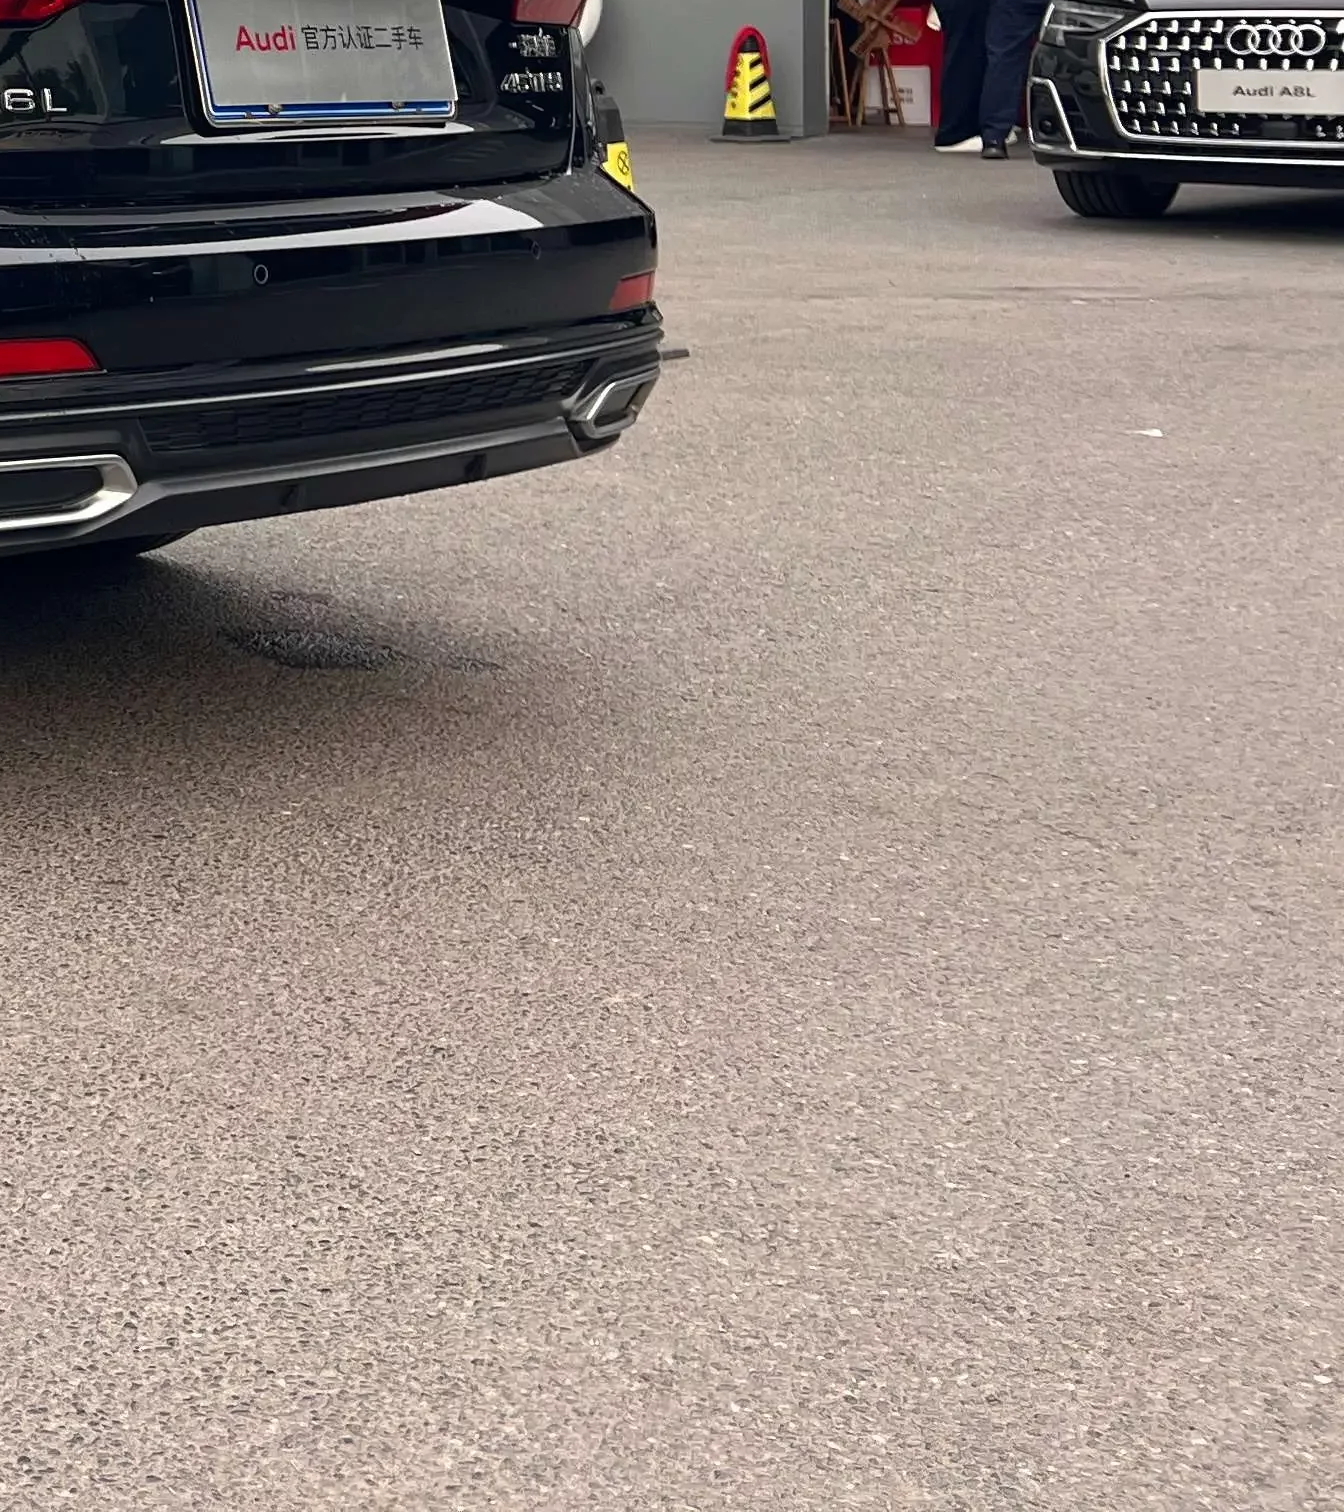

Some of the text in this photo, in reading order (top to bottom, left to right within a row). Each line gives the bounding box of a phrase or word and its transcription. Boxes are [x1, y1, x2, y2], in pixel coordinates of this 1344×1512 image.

[235, 23, 425, 52] Audi 官方认证二手车
[1232, 84, 1318, 98] Audi A8L
